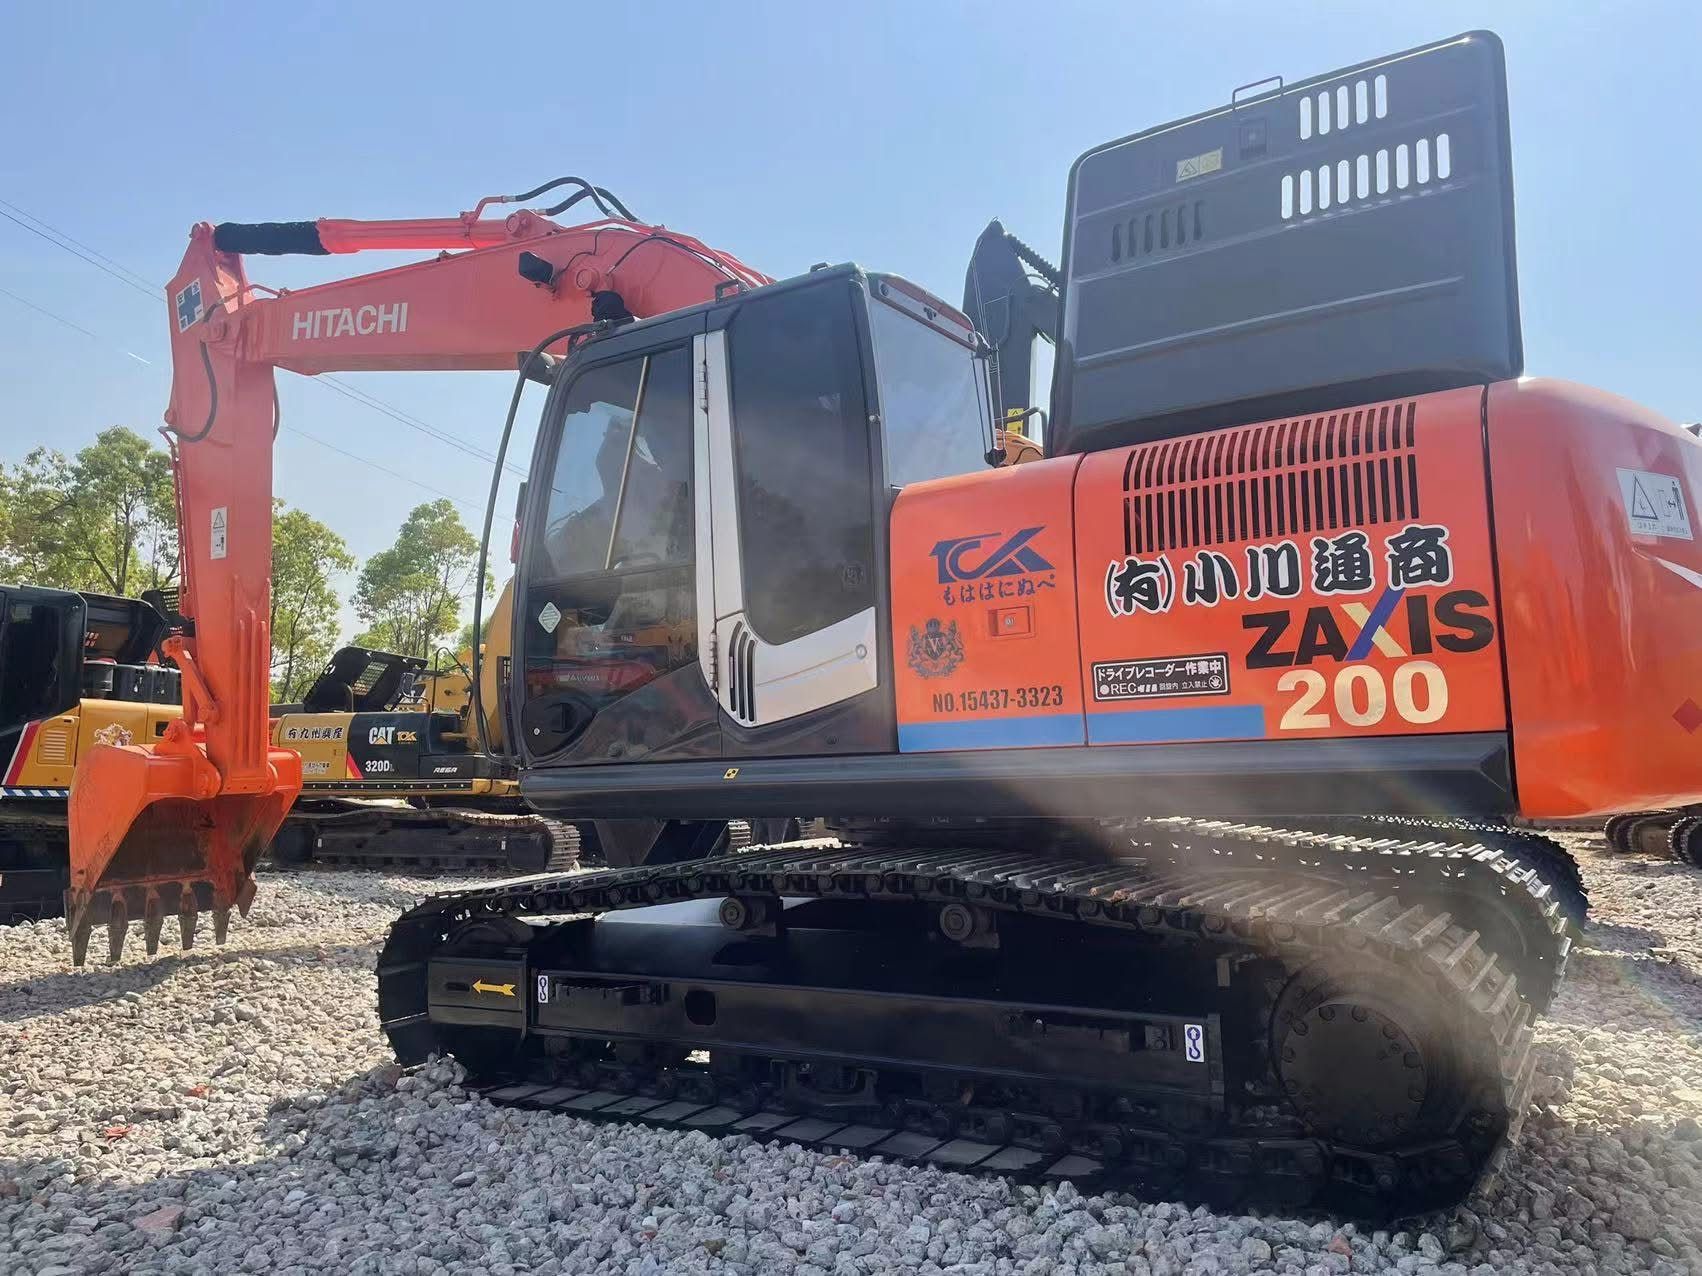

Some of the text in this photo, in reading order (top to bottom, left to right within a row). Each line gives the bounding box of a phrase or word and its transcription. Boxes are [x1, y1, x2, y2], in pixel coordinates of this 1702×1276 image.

[292, 302, 409, 340] HITACHI
[1241, 586, 1494, 670] ZAXIS
[1097, 659, 1222, 682] ドライブレコーダー作業中
[932, 685, 1064, 713] NO.15437-3323
[1276, 660, 1448, 730] 200
[368, 726, 396, 745] CAT
